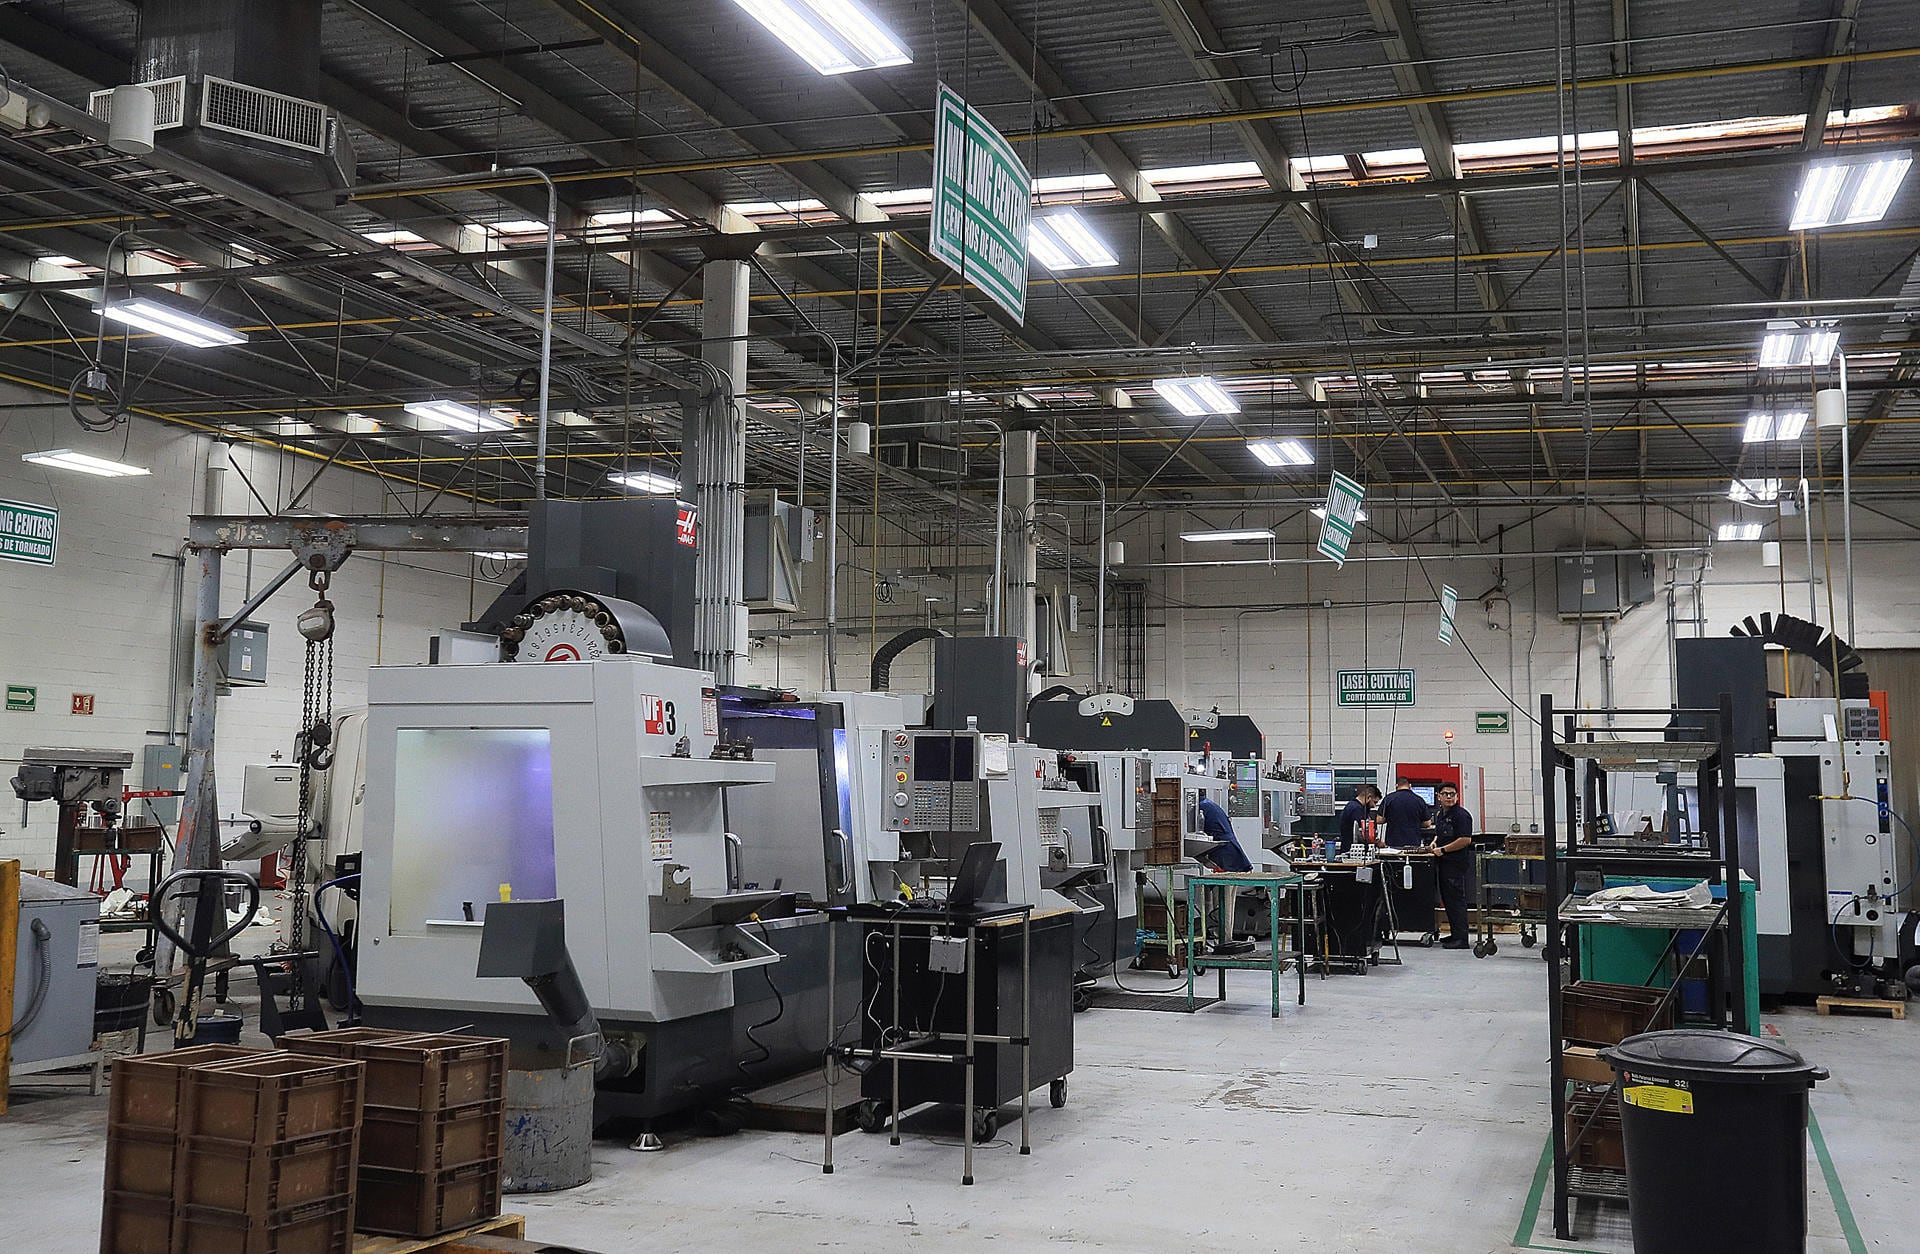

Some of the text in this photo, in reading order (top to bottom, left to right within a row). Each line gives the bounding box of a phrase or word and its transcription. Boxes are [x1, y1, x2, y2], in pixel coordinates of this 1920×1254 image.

[993, 163, 1027, 248] CENTERS
[980, 228, 989, 261] DE
[14, 512, 53, 539] CENTERS
[4, 539, 13, 550] DE
[15, 541, 50, 556] TORNEADO
[553, 623, 558, 633] 5
[570, 623, 575, 633] 3
[576, 627, 584, 636] 2
[1342, 674, 1410, 690] LASER CUTTING
[1385, 693, 1407, 701] LASER
[665, 701, 676, 736] 3
[1674, 1079, 1686, 1088] 32
